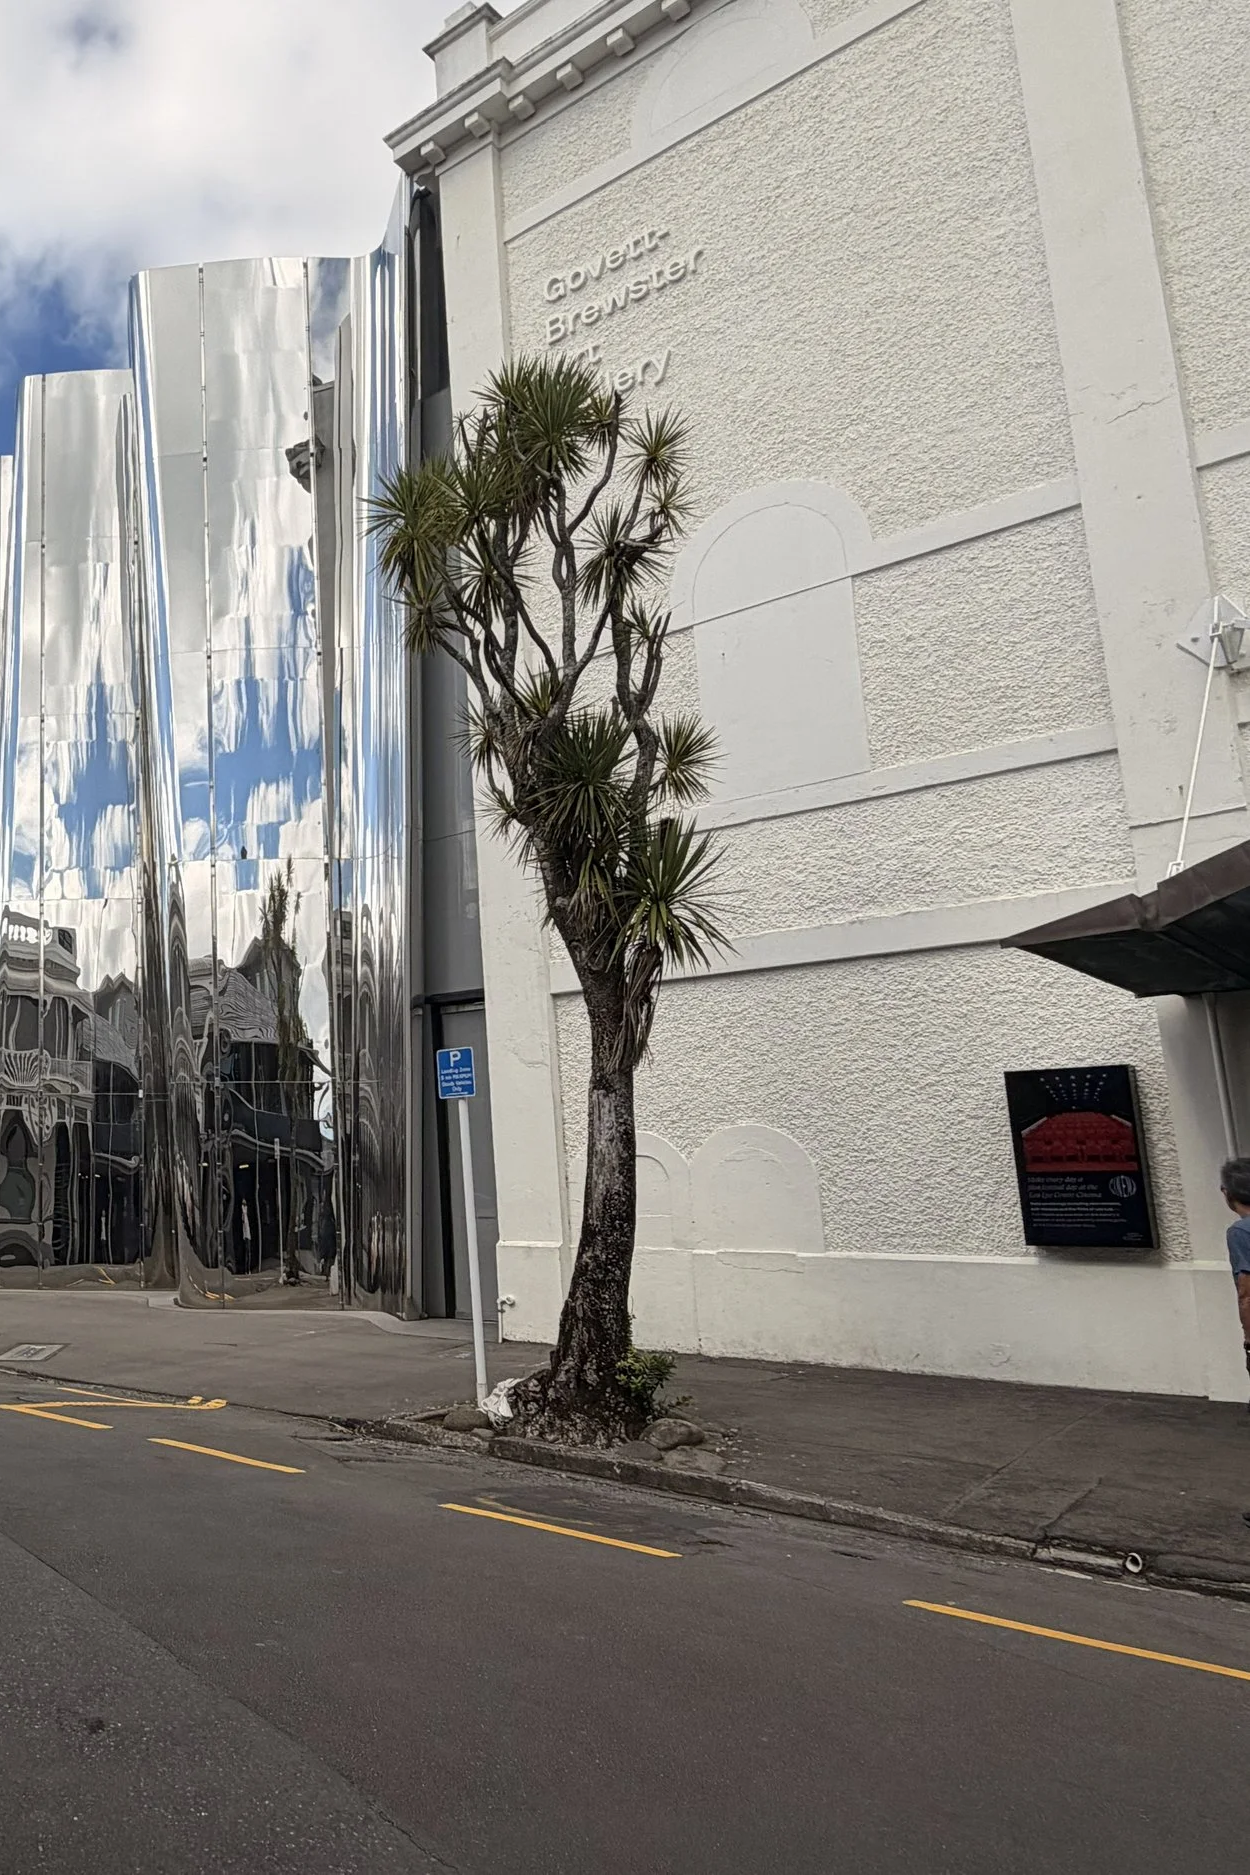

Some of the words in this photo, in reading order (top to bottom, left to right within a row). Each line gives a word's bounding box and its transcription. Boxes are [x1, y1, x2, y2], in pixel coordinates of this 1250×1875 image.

[544, 229, 670, 303] Govett-
[546, 250, 704, 345] Brewster
[450, 1051, 461, 1067] P
